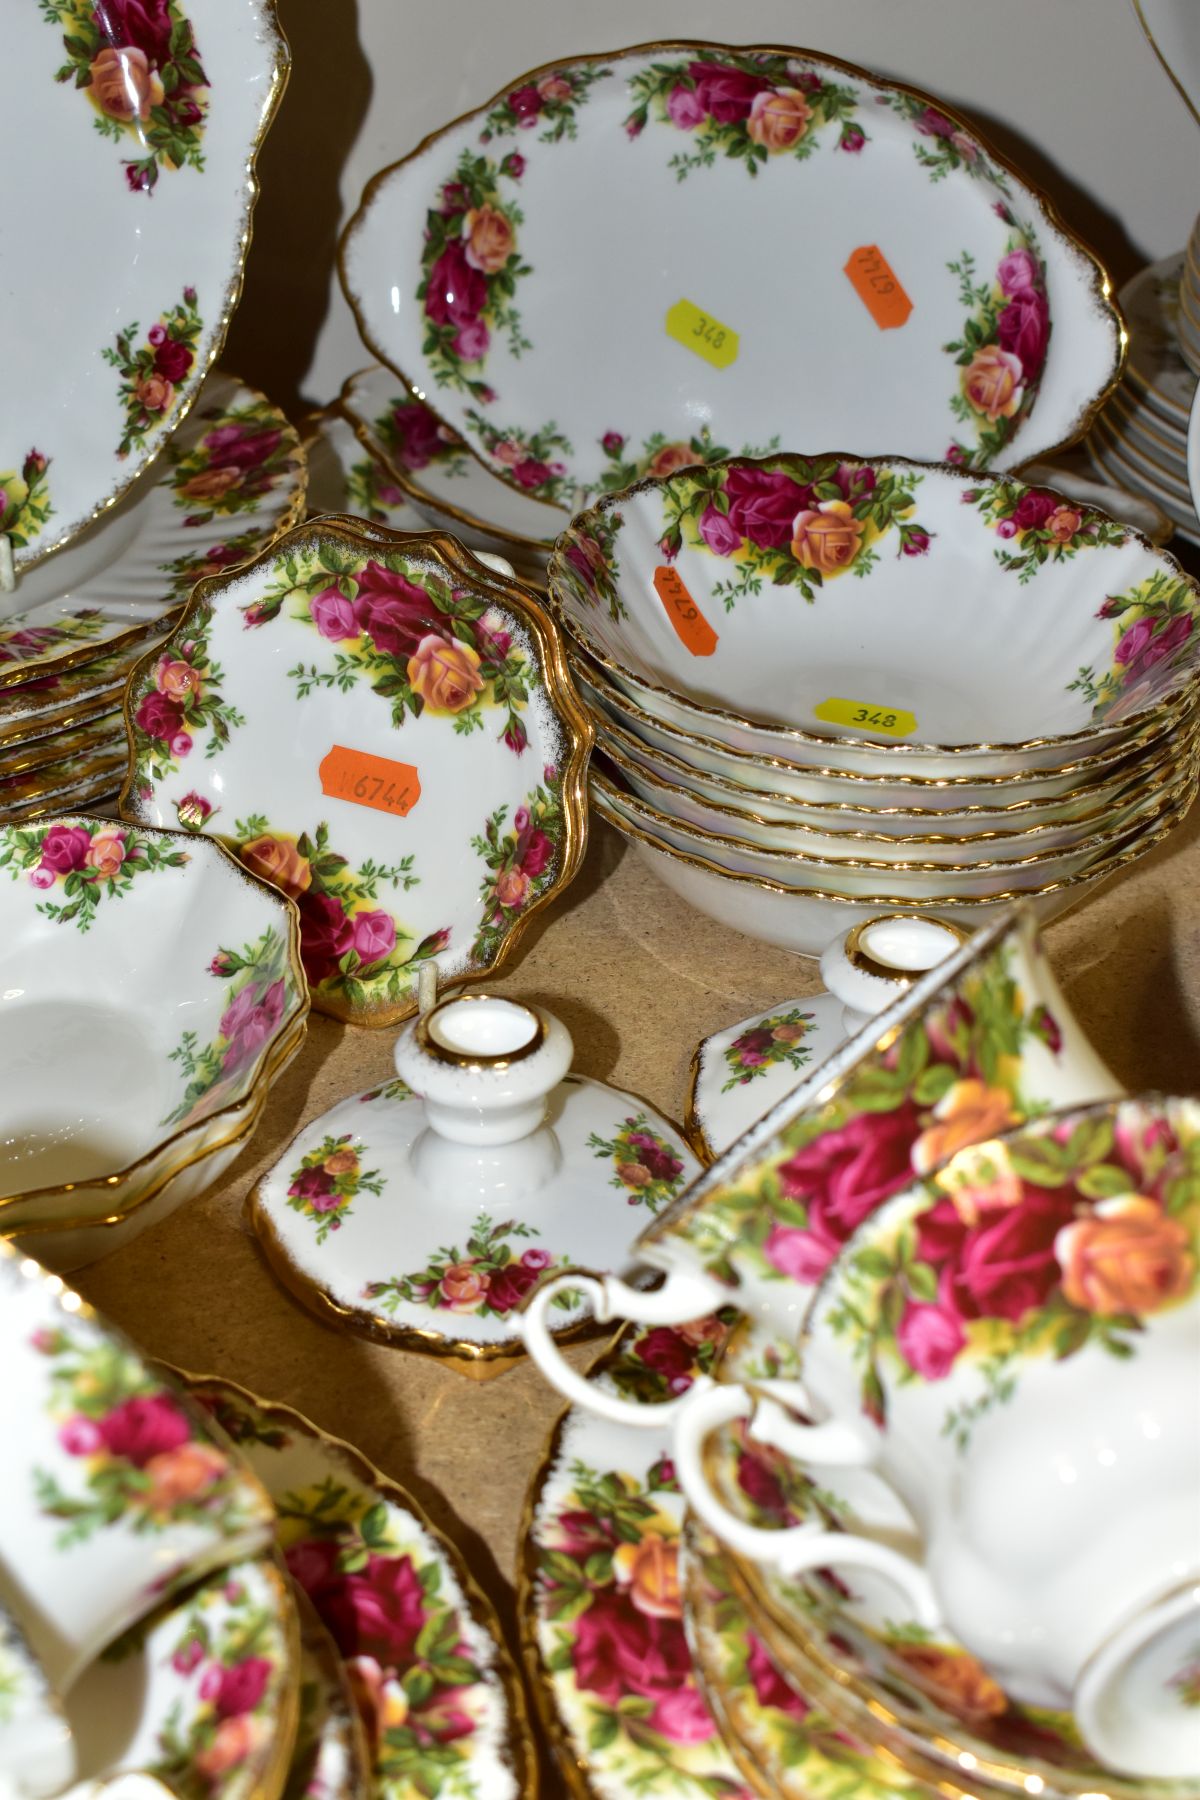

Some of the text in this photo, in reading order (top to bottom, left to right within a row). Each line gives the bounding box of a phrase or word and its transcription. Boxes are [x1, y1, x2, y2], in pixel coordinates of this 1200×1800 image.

[692, 317, 727, 350] 348
[662, 570, 698, 620] 6744
[852, 709, 897, 728] 348
[353, 775, 410, 811] 6744
